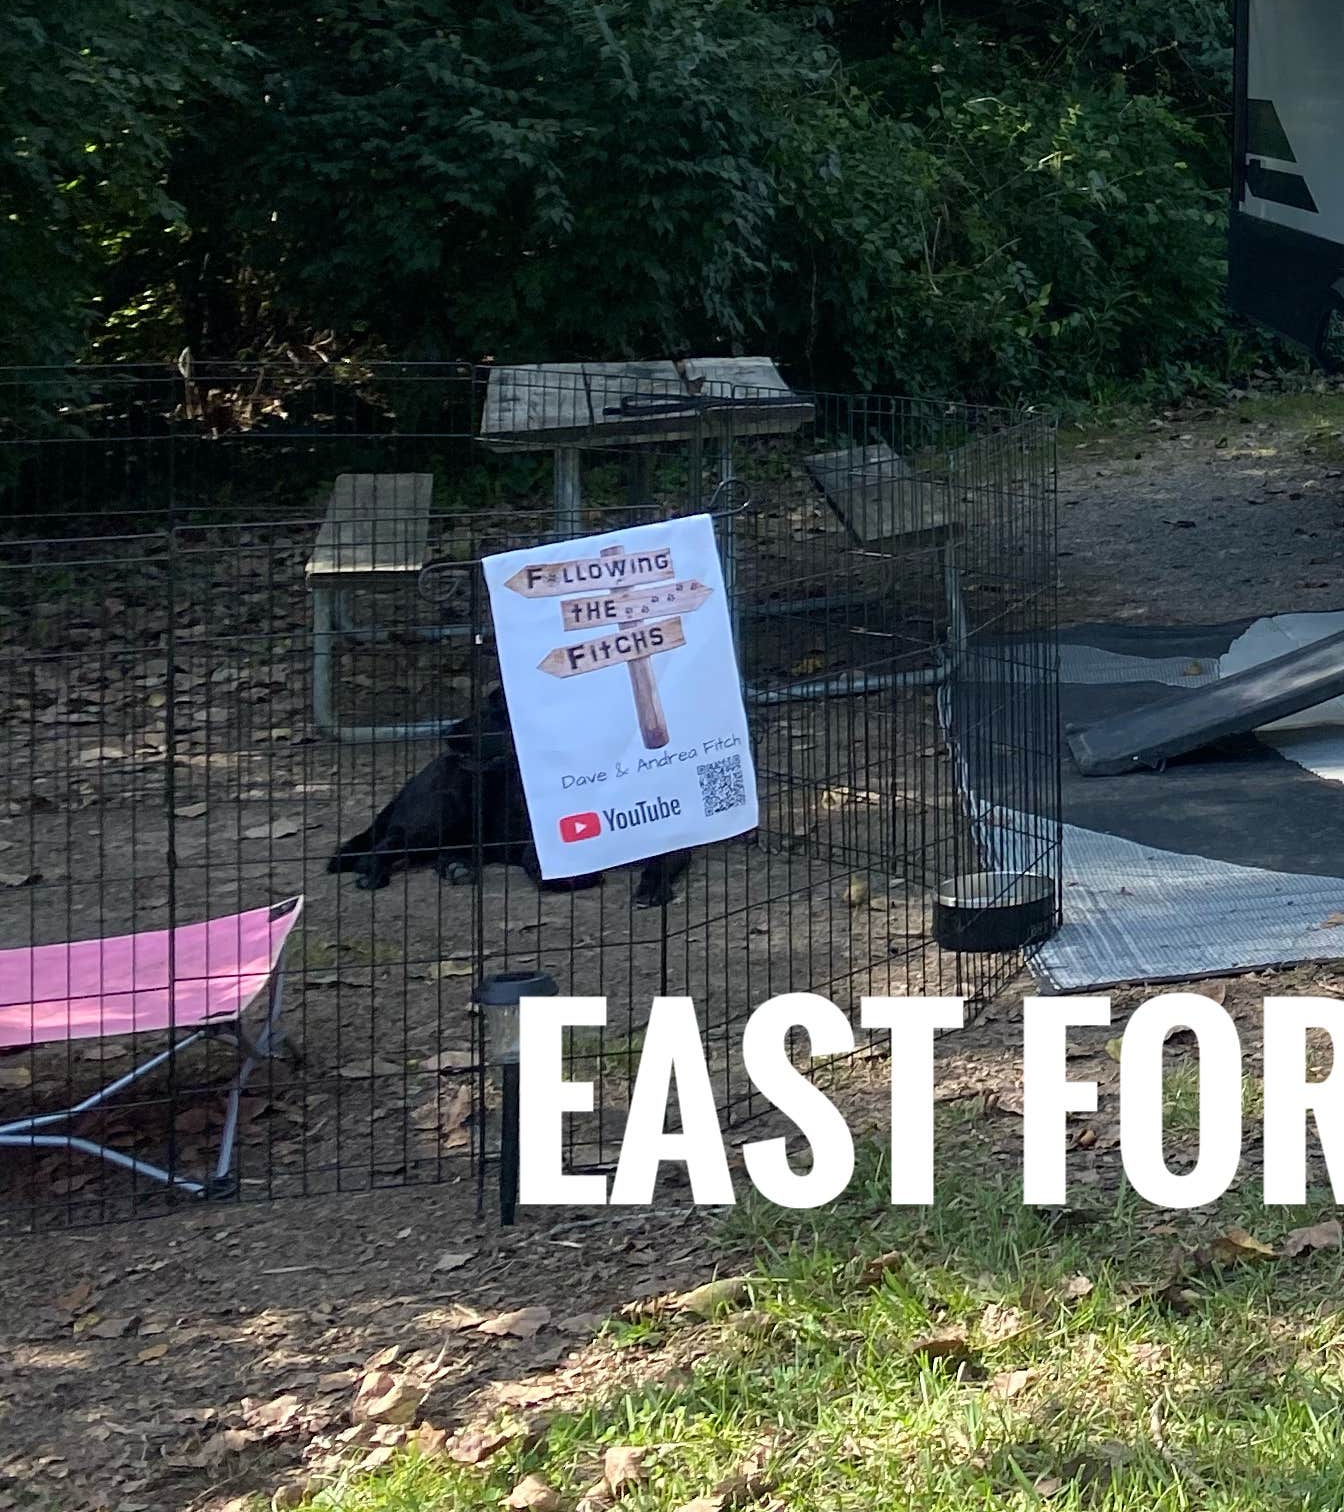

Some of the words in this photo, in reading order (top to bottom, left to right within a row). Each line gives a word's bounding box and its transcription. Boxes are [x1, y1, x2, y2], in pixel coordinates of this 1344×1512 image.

[561, 769, 608, 790] Dave
[615, 761, 631, 779] &
[636, 746, 698, 773] Andrea
[702, 732, 742, 755] Fitch
[602, 795, 682, 832] YouTube
